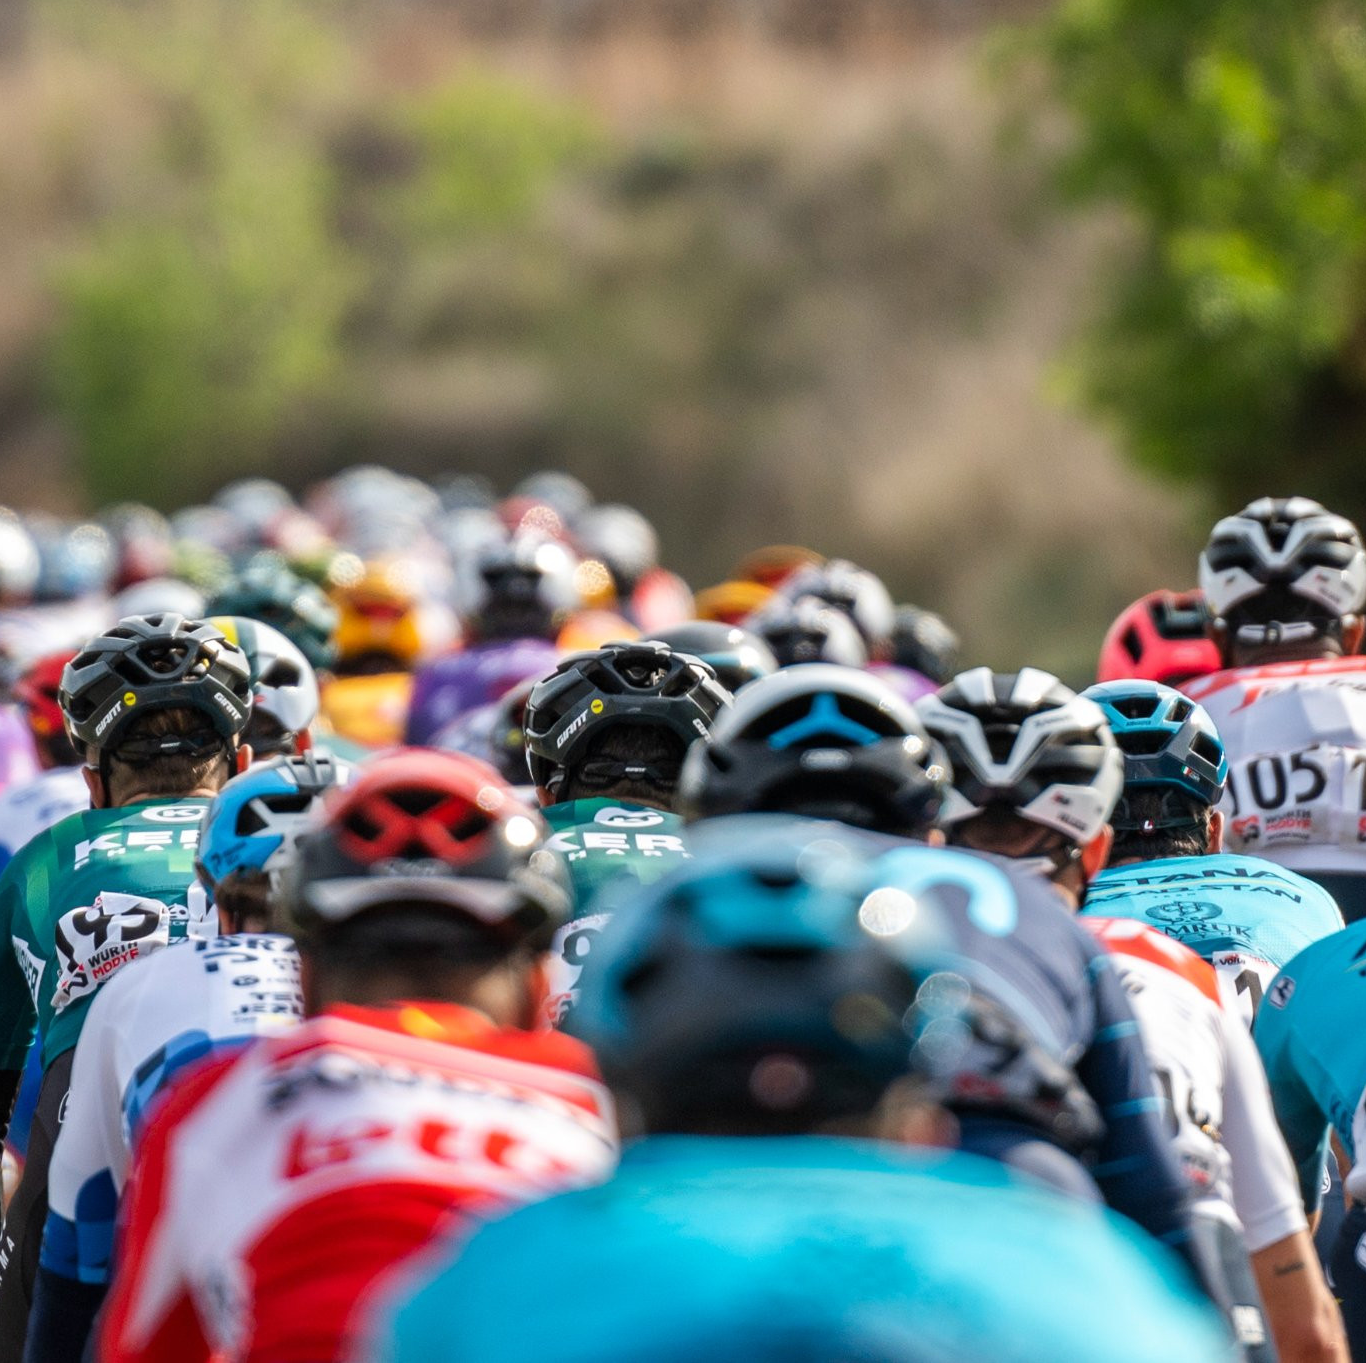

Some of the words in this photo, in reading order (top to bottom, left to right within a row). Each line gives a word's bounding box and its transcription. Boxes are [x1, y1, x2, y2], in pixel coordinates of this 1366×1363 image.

[95, 700, 122, 737] GIANT
[213, 691, 243, 721] GIANT
[556, 709, 589, 750] GIANT
[92, 948, 140, 980] MODYF
